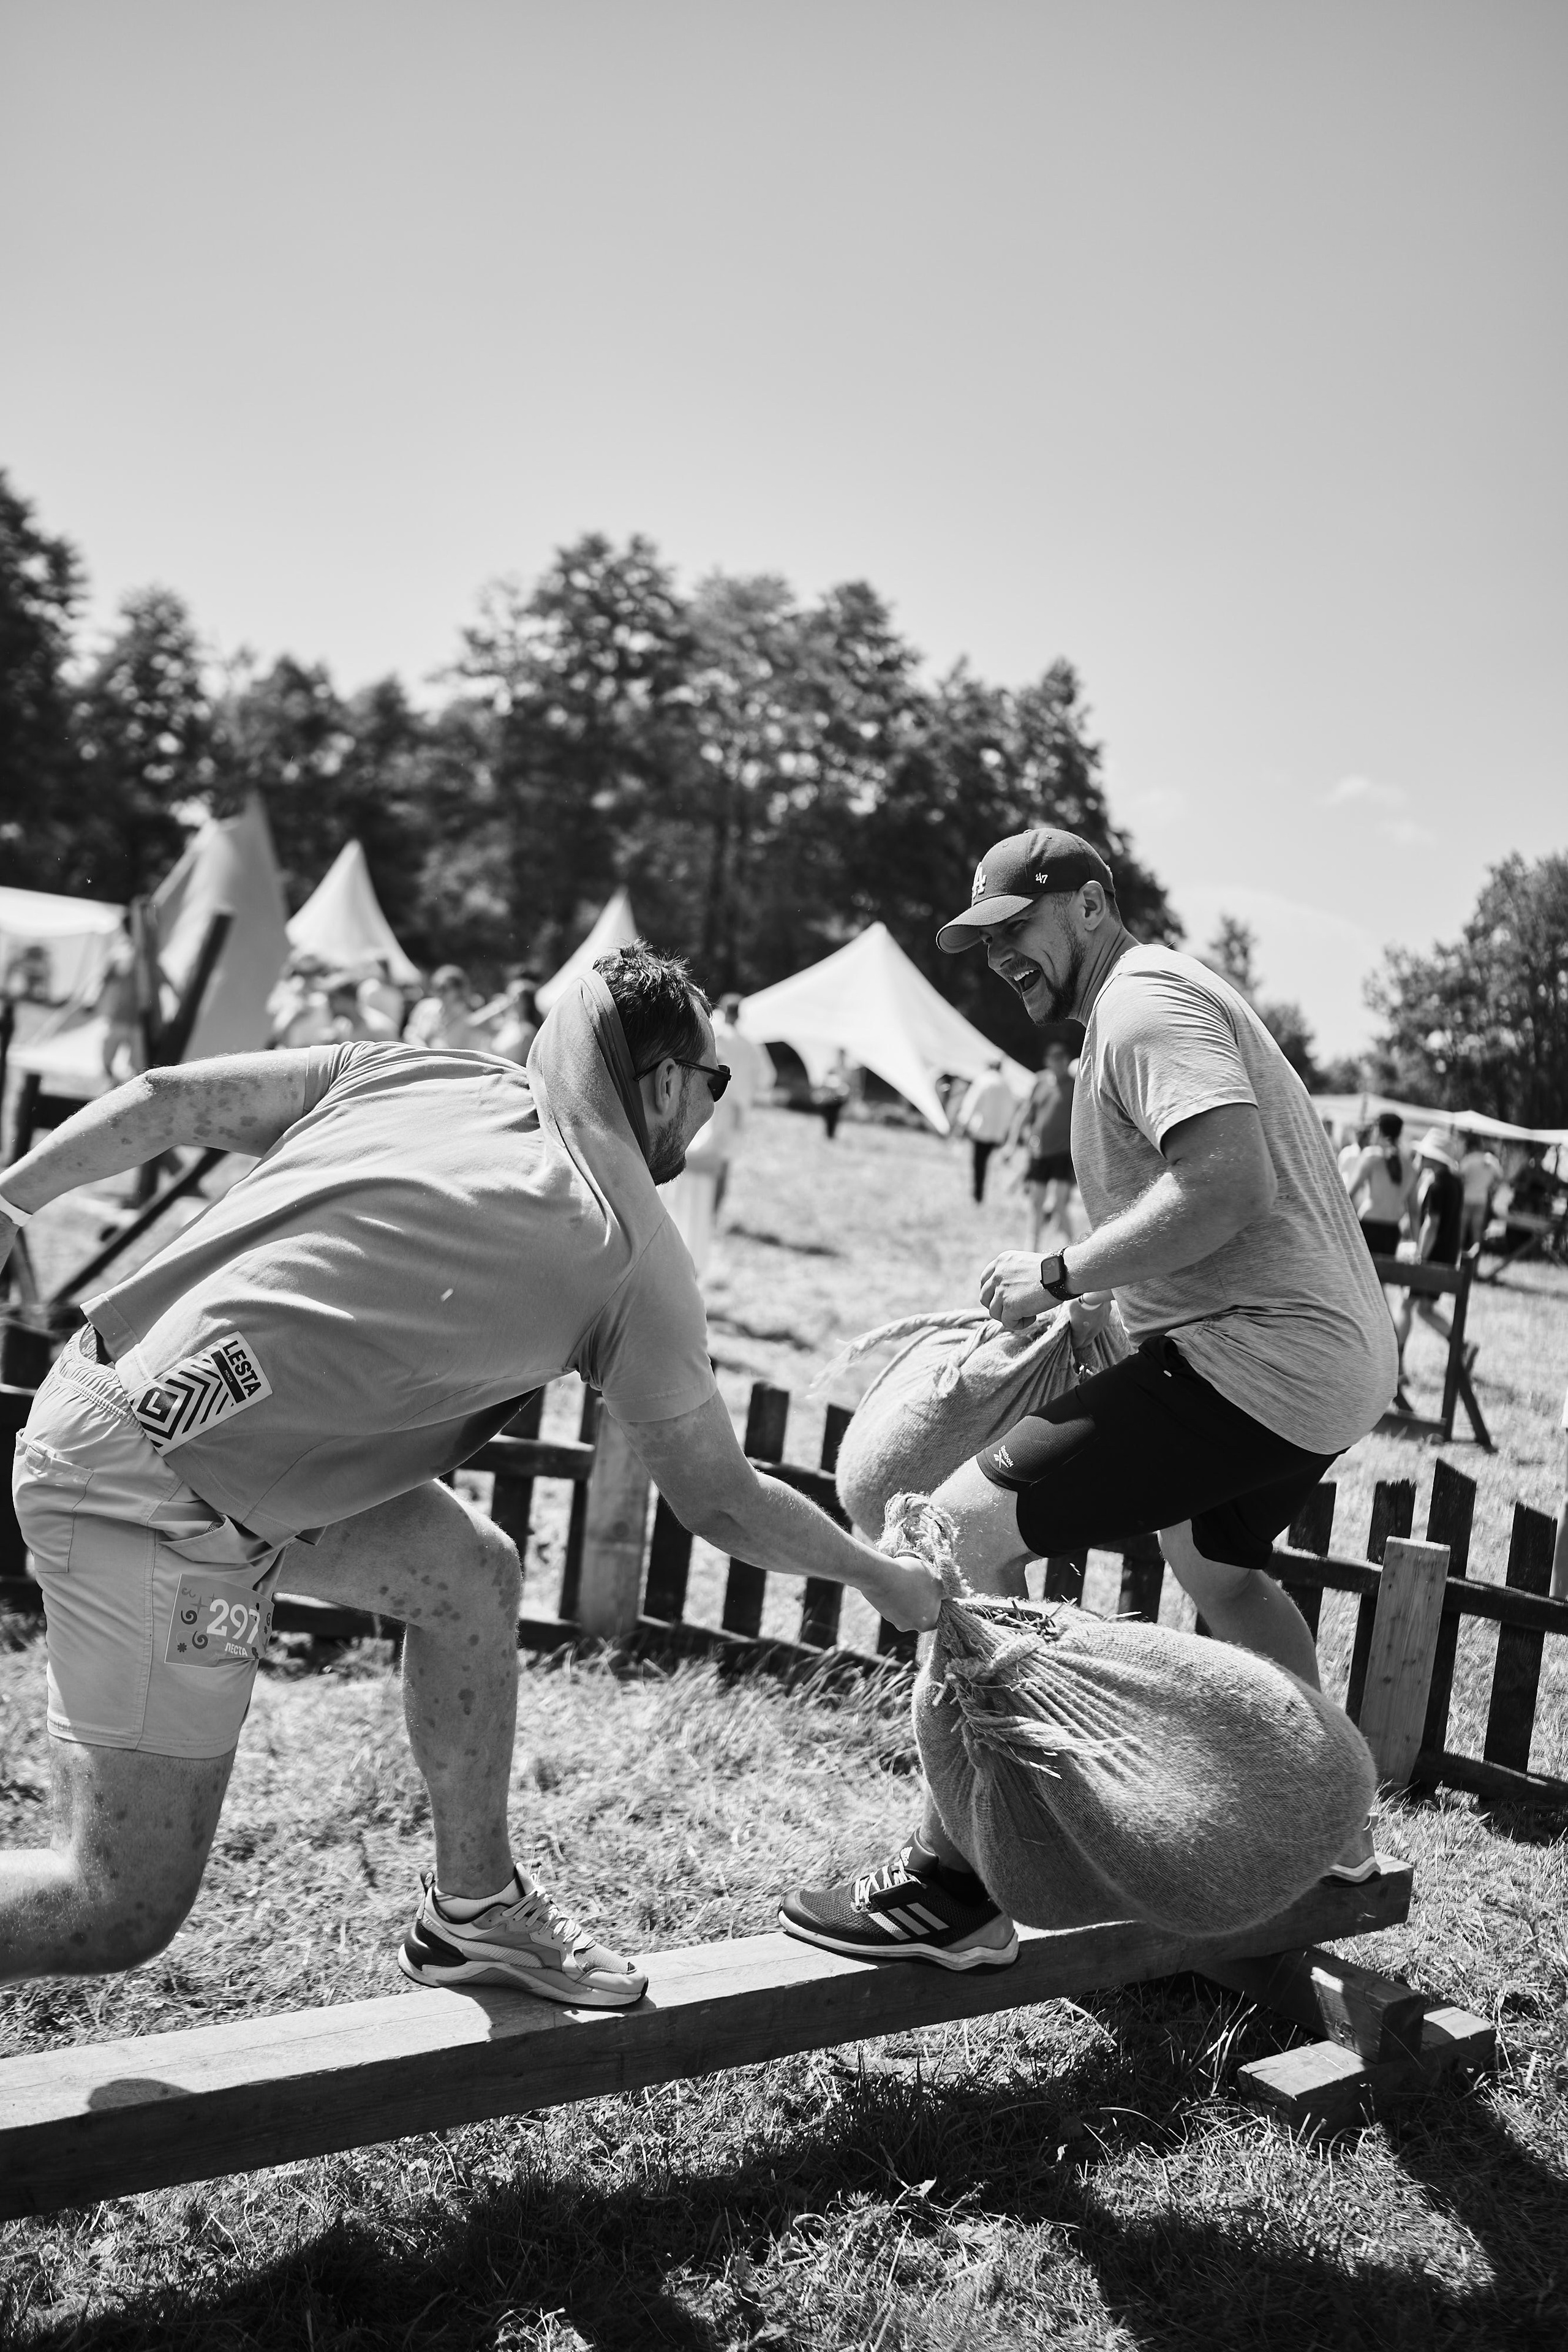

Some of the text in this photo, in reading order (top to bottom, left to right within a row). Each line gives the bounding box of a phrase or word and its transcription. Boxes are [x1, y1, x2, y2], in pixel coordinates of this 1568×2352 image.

[222, 1340, 262, 1397] LESTA
[224, 1370, 233, 1383] MINSK
[1000, 1444, 1014, 1467] Reebok
[206, 1599, 260, 1645] 297
[225, 1642, 248, 1657] ЛЕСТА
